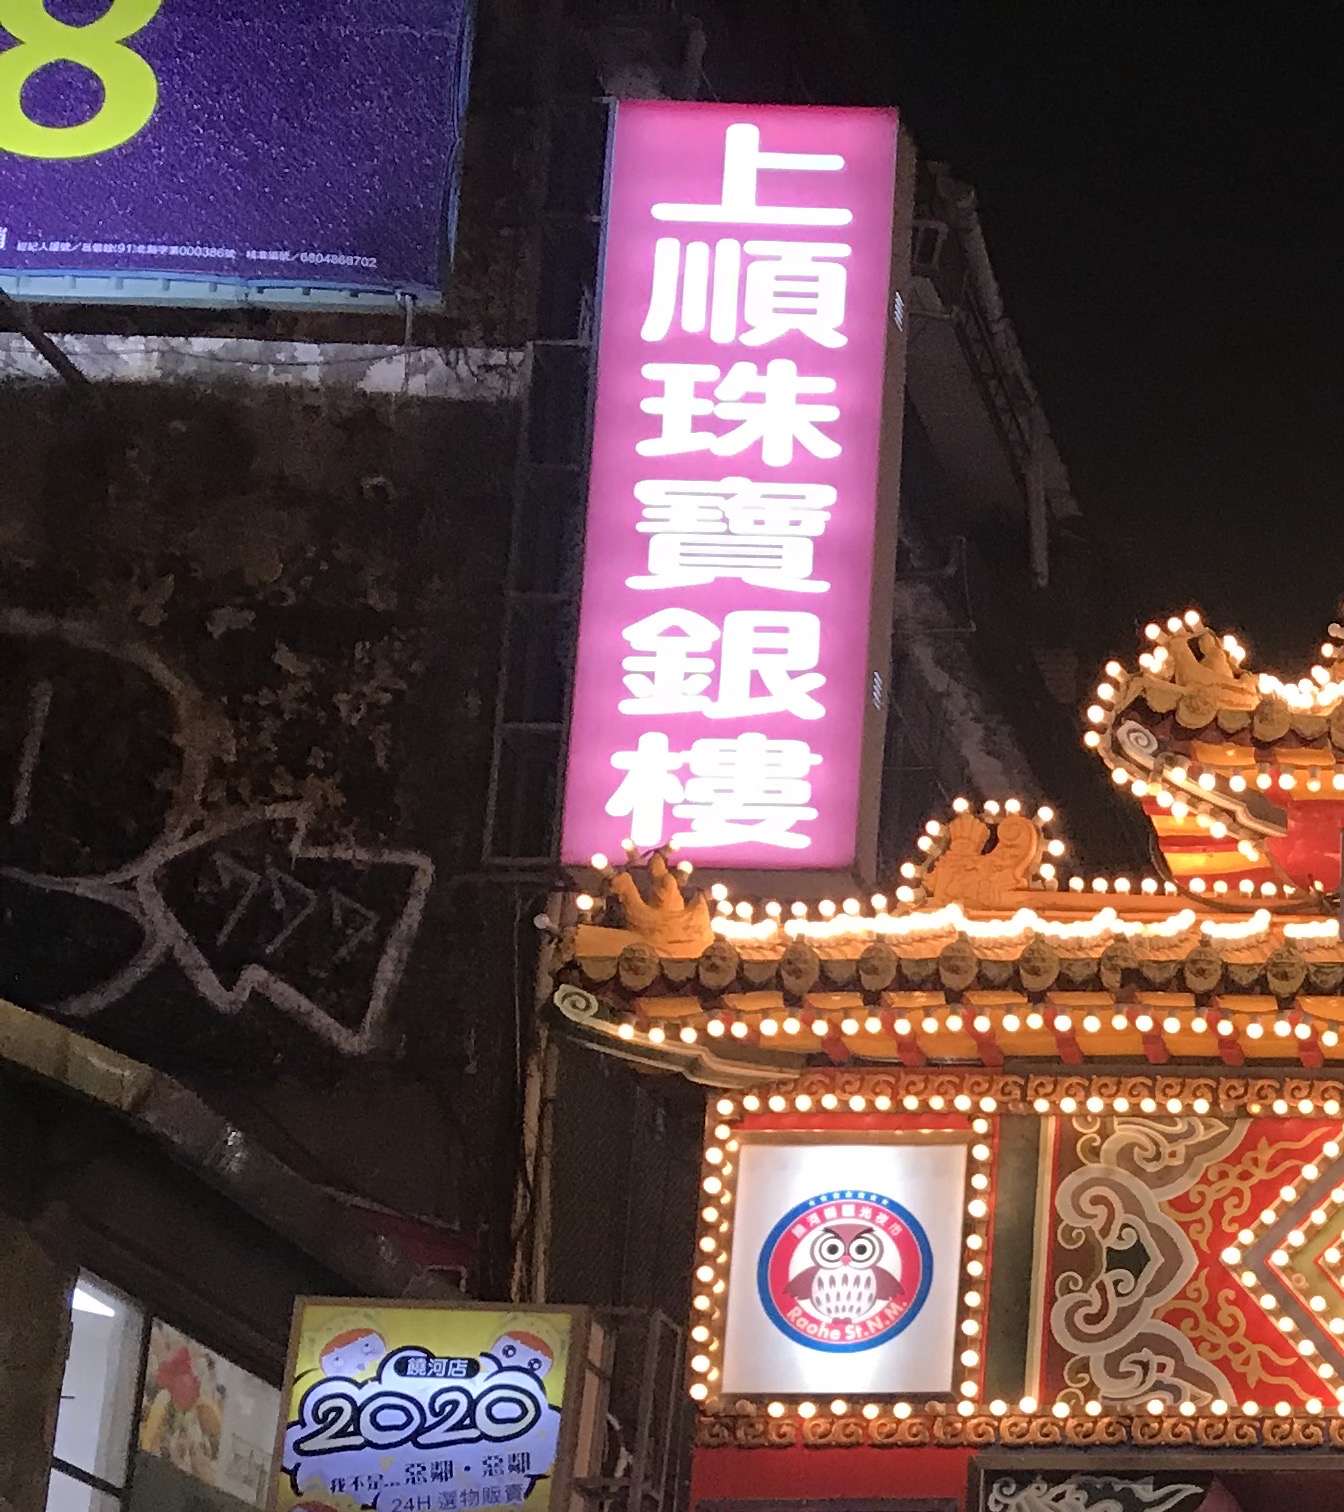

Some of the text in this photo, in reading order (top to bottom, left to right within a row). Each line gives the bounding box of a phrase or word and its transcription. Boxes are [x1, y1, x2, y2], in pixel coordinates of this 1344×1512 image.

[606, 123, 853, 849] 上順珠寶銀樓
[786, 1305, 841, 1341] Raohe
[406, 1357, 469, 1378] 饒河店
[293, 1384, 542, 1457] 2020
